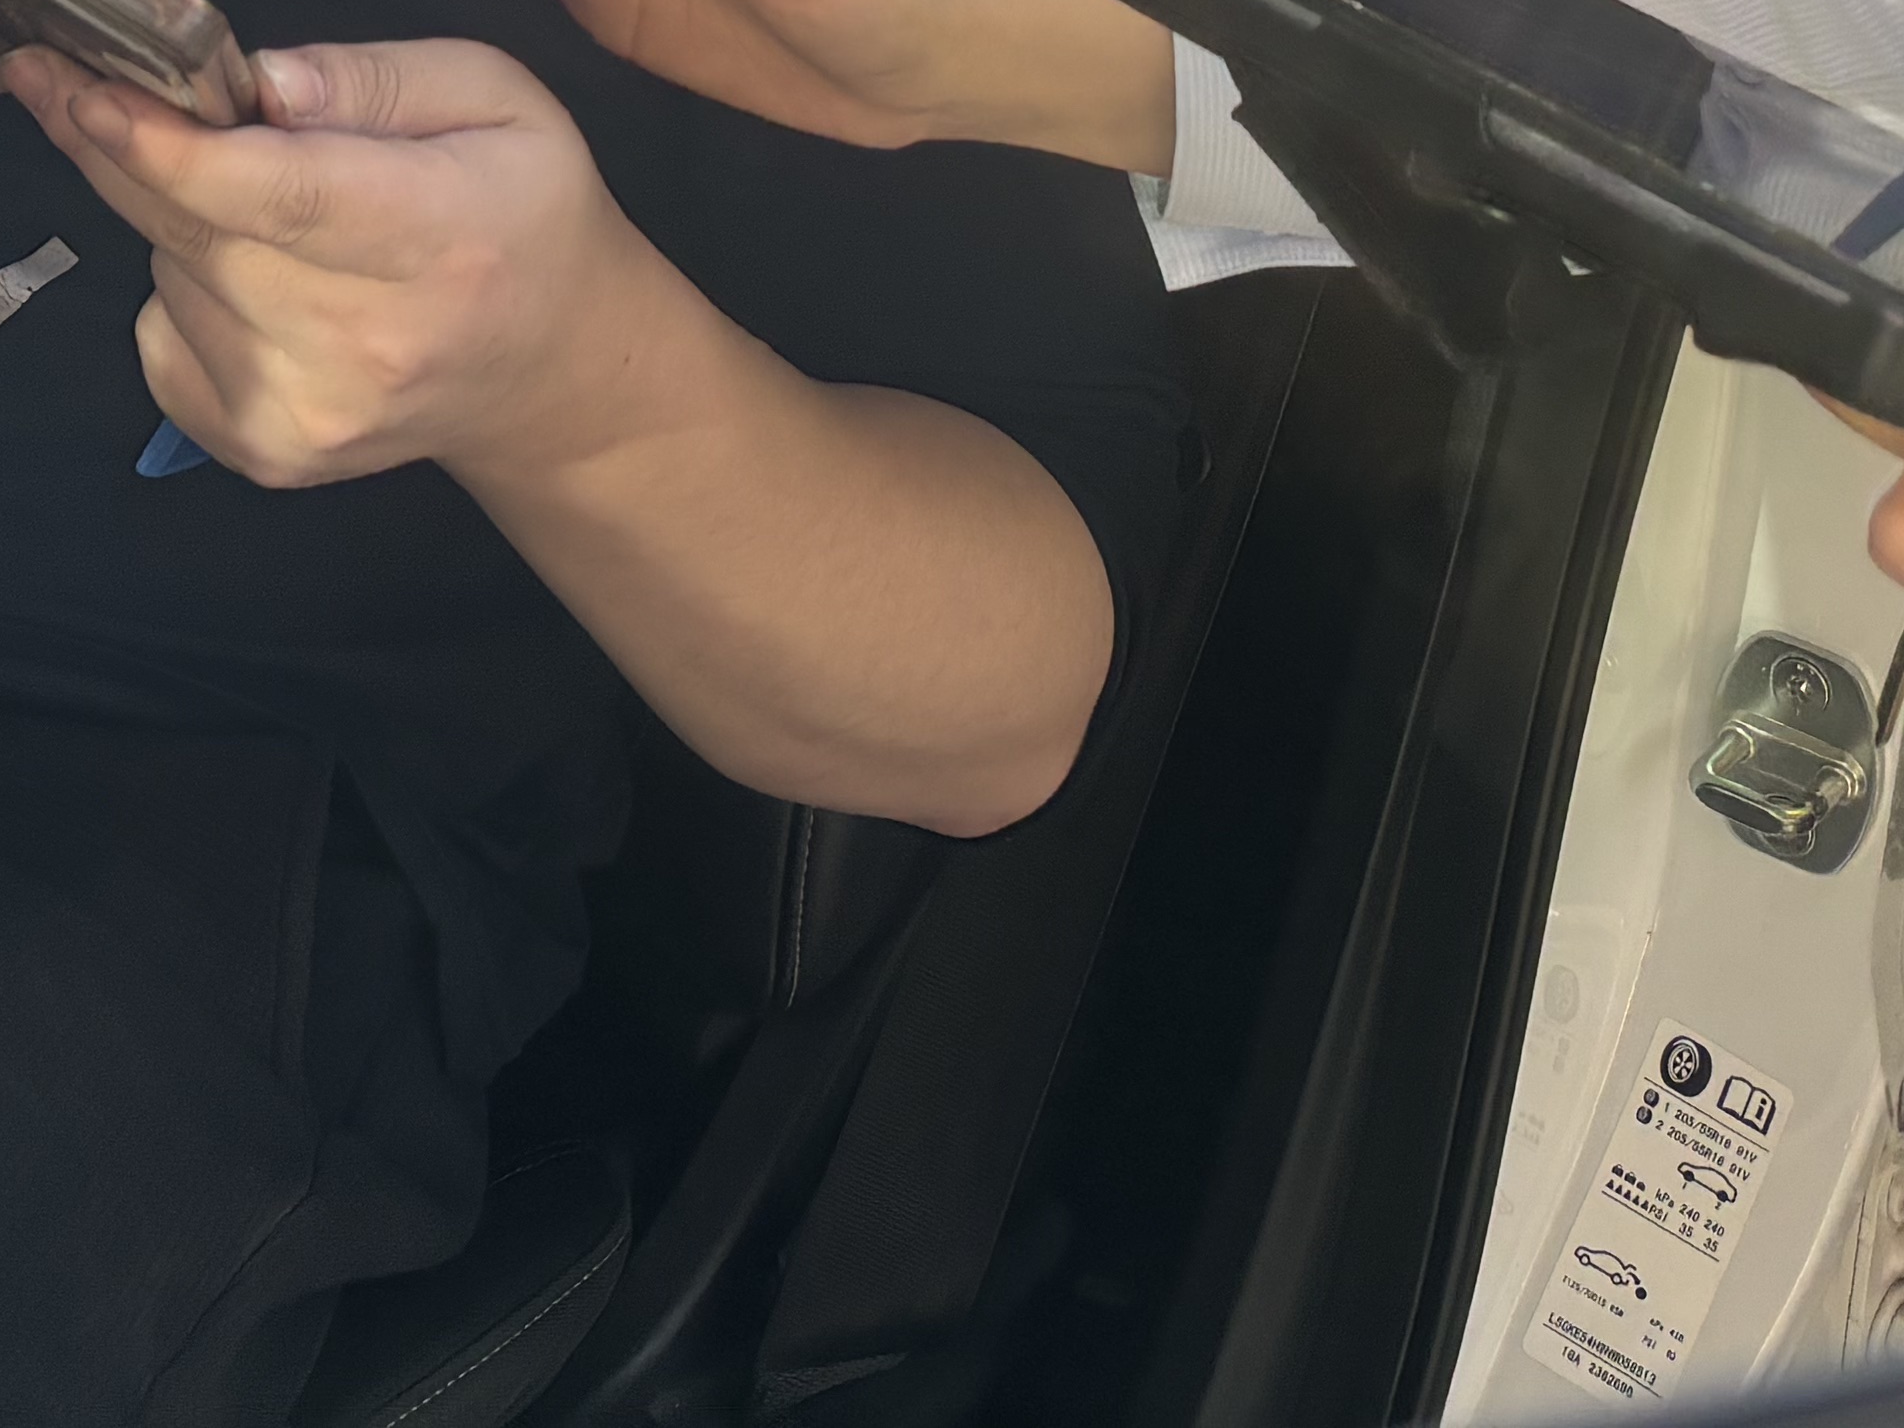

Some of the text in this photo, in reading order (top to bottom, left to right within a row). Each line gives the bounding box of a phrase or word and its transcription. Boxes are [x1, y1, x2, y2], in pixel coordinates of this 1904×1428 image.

[1678, 1203, 1701, 1223] 240
[1703, 1219, 1725, 1237] 240
[1678, 1223, 1694, 1238] 35
[1702, 1237, 1719, 1253] 35
